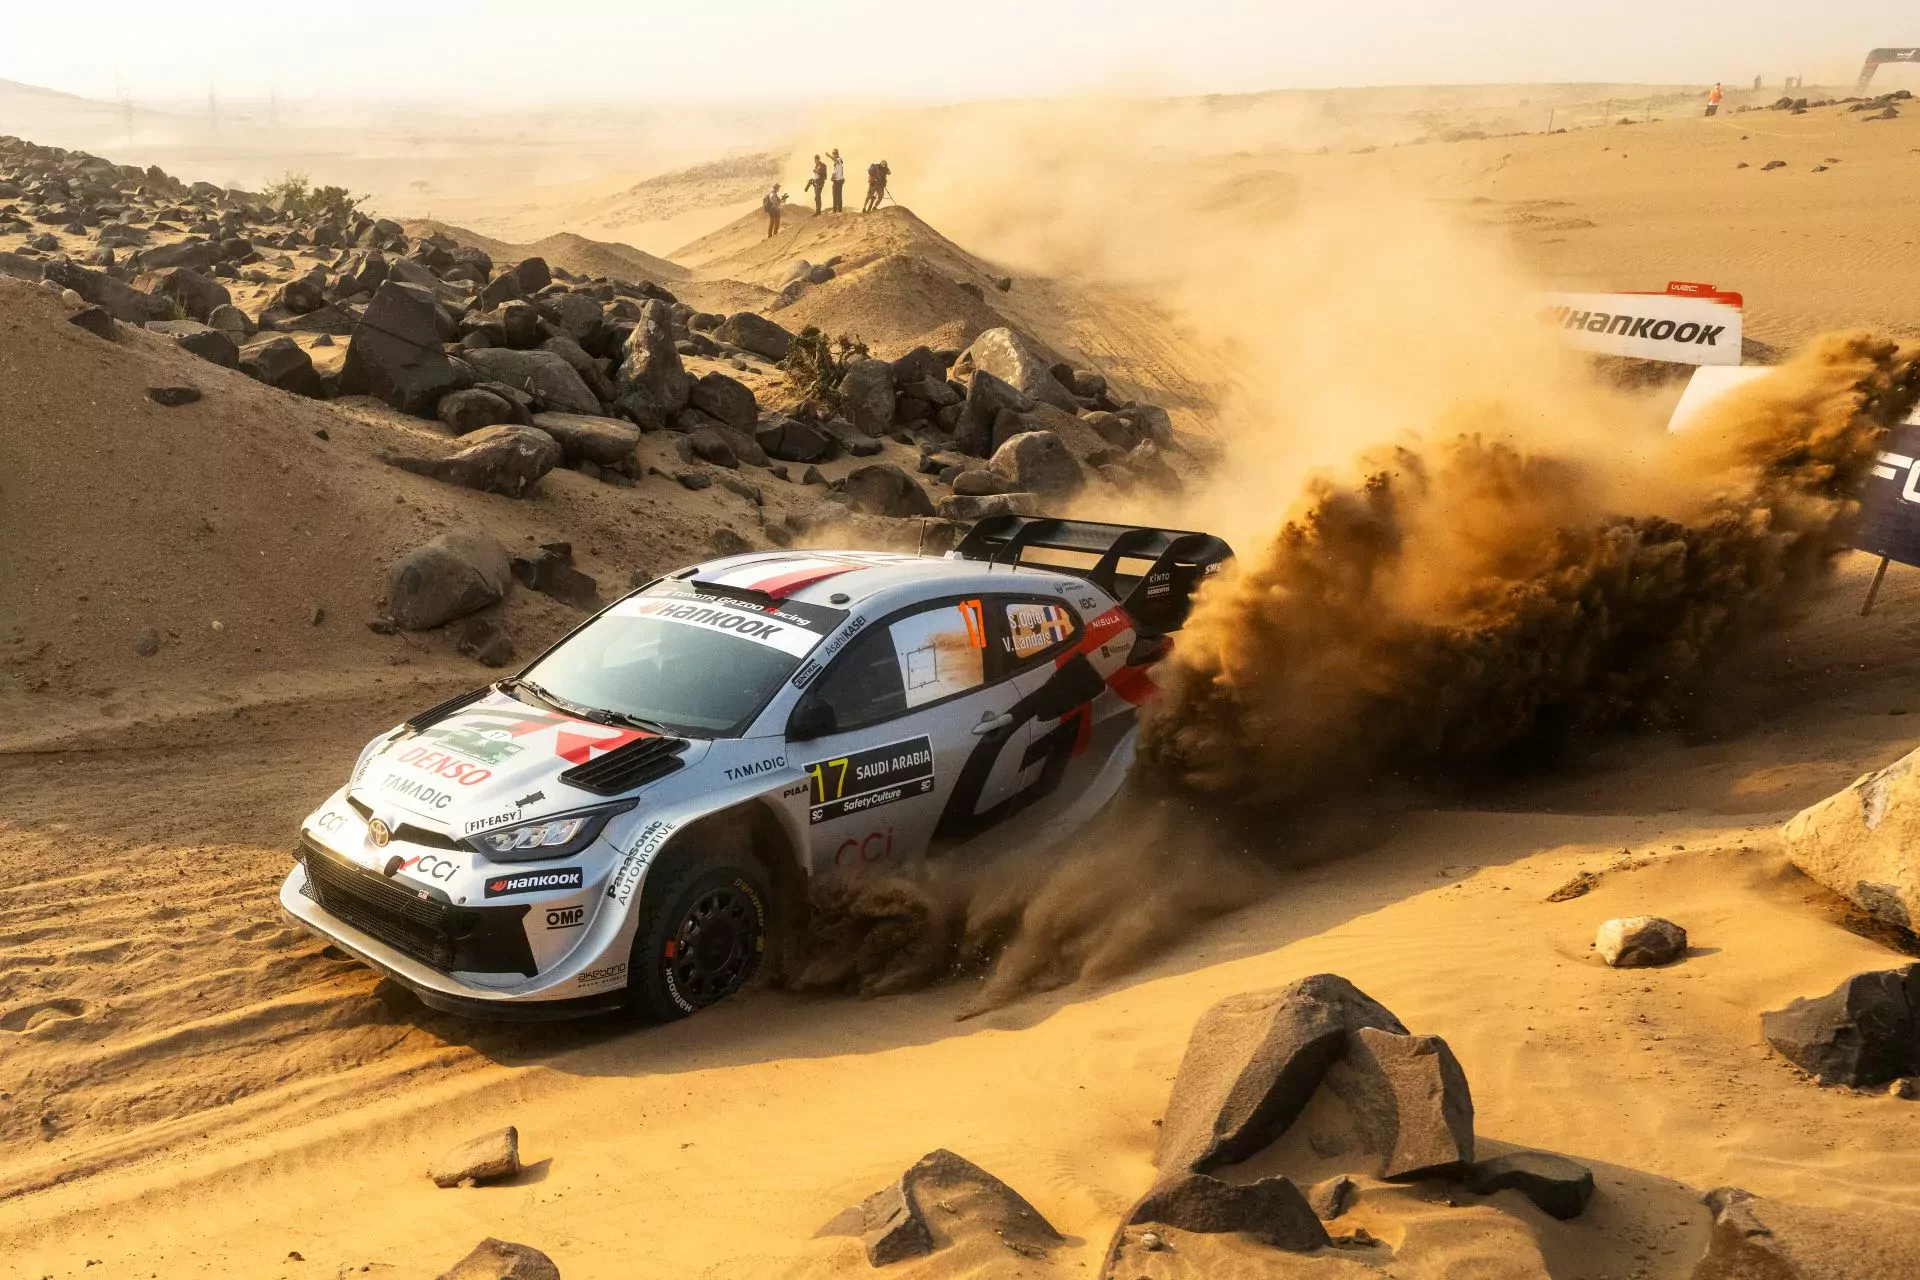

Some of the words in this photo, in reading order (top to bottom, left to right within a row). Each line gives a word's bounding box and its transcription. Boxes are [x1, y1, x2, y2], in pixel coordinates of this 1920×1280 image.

[957, 599, 987, 649] 17
[1092, 615, 1120, 629] NISULA
[793, 661, 821, 688] CENTRAL
[397, 746, 492, 786] DENSO
[724, 756, 785, 781] TAMADIC
[811, 757, 849, 803] 17
[856, 761, 889, 781] SAUDI
[892, 750, 931, 770] ARABIA
[381, 773, 452, 809] TAMADIC
[783, 783, 809, 799] PIAA
[606, 819, 663, 900] Panasonic
[618, 822, 676, 907] AUTOMOTIVE
[546, 909, 584, 926] OMP
